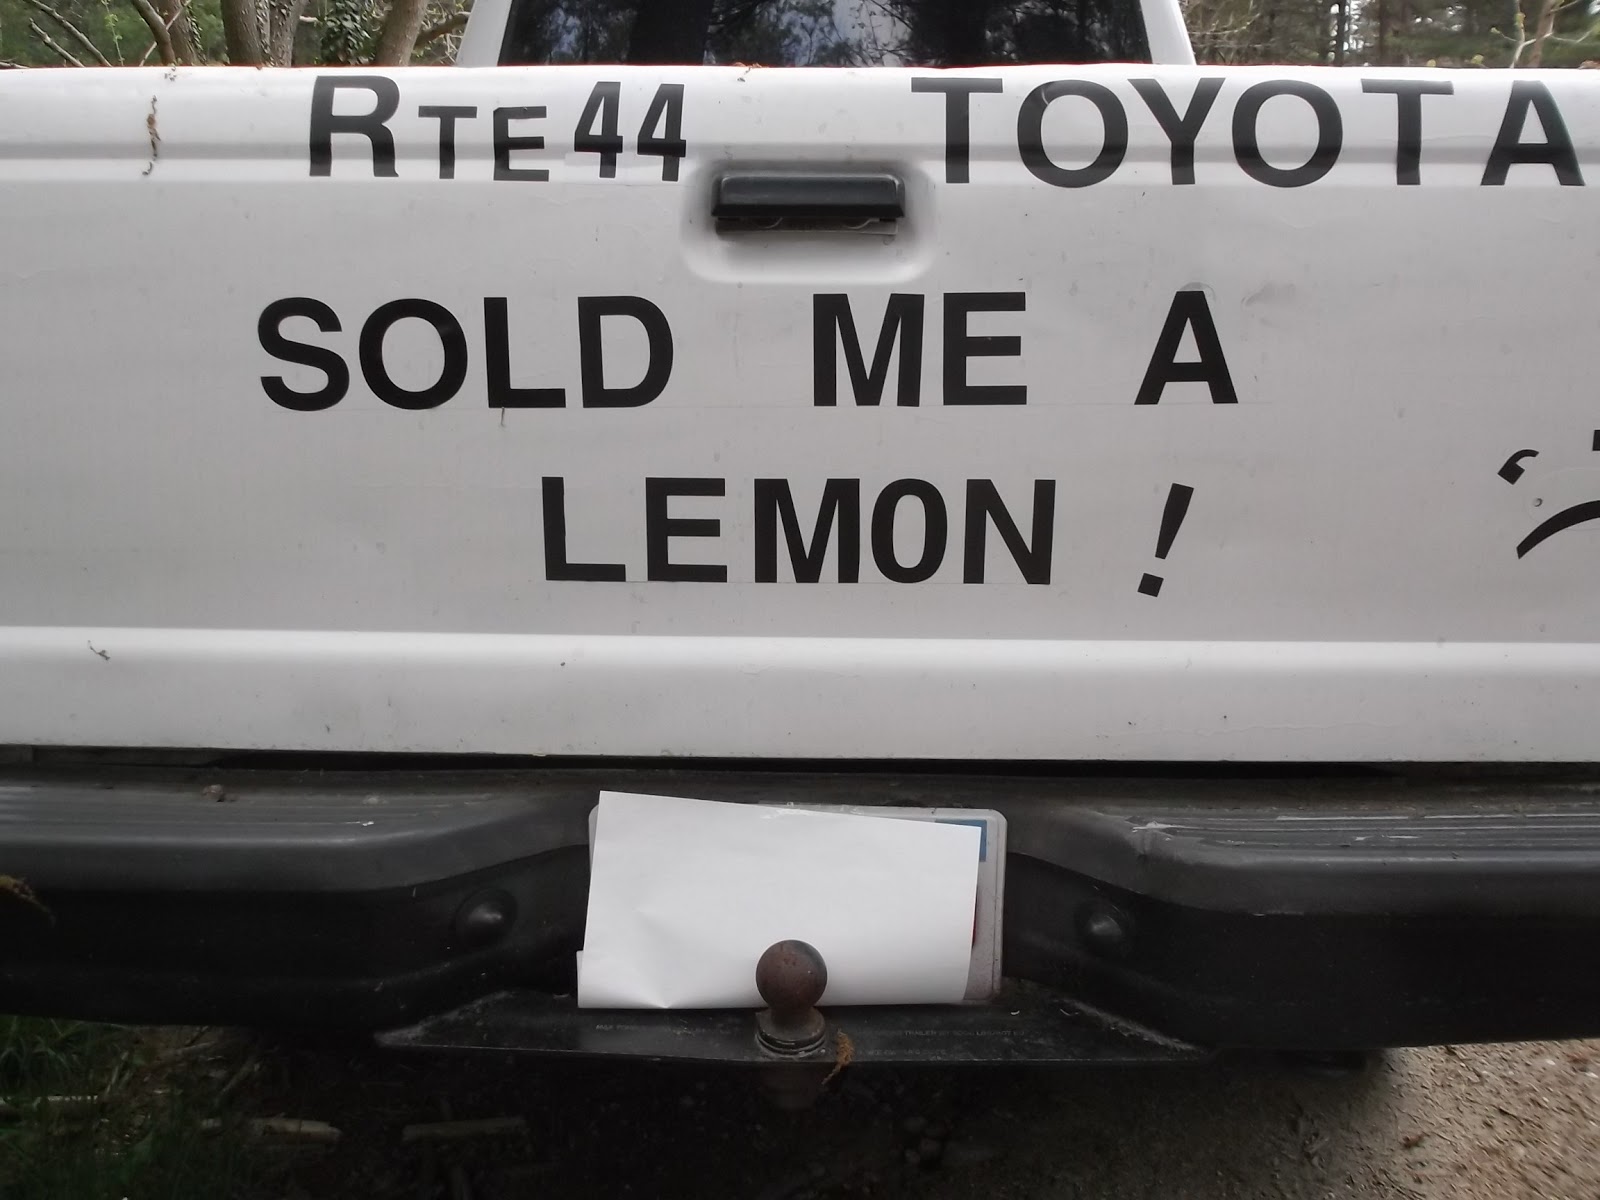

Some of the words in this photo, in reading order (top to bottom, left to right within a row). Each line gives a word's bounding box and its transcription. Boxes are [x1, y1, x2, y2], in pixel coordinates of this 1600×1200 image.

[573, 81, 687, 182] 44
[911, 77, 1586, 188] TOYOTA
[257, 295, 674, 412] SOLD
[813, 292, 1028, 408] ME
[1134, 290, 1239, 406] A
[541, 476, 1056, 585] LEMON
[1137, 482, 1195, 598] !
